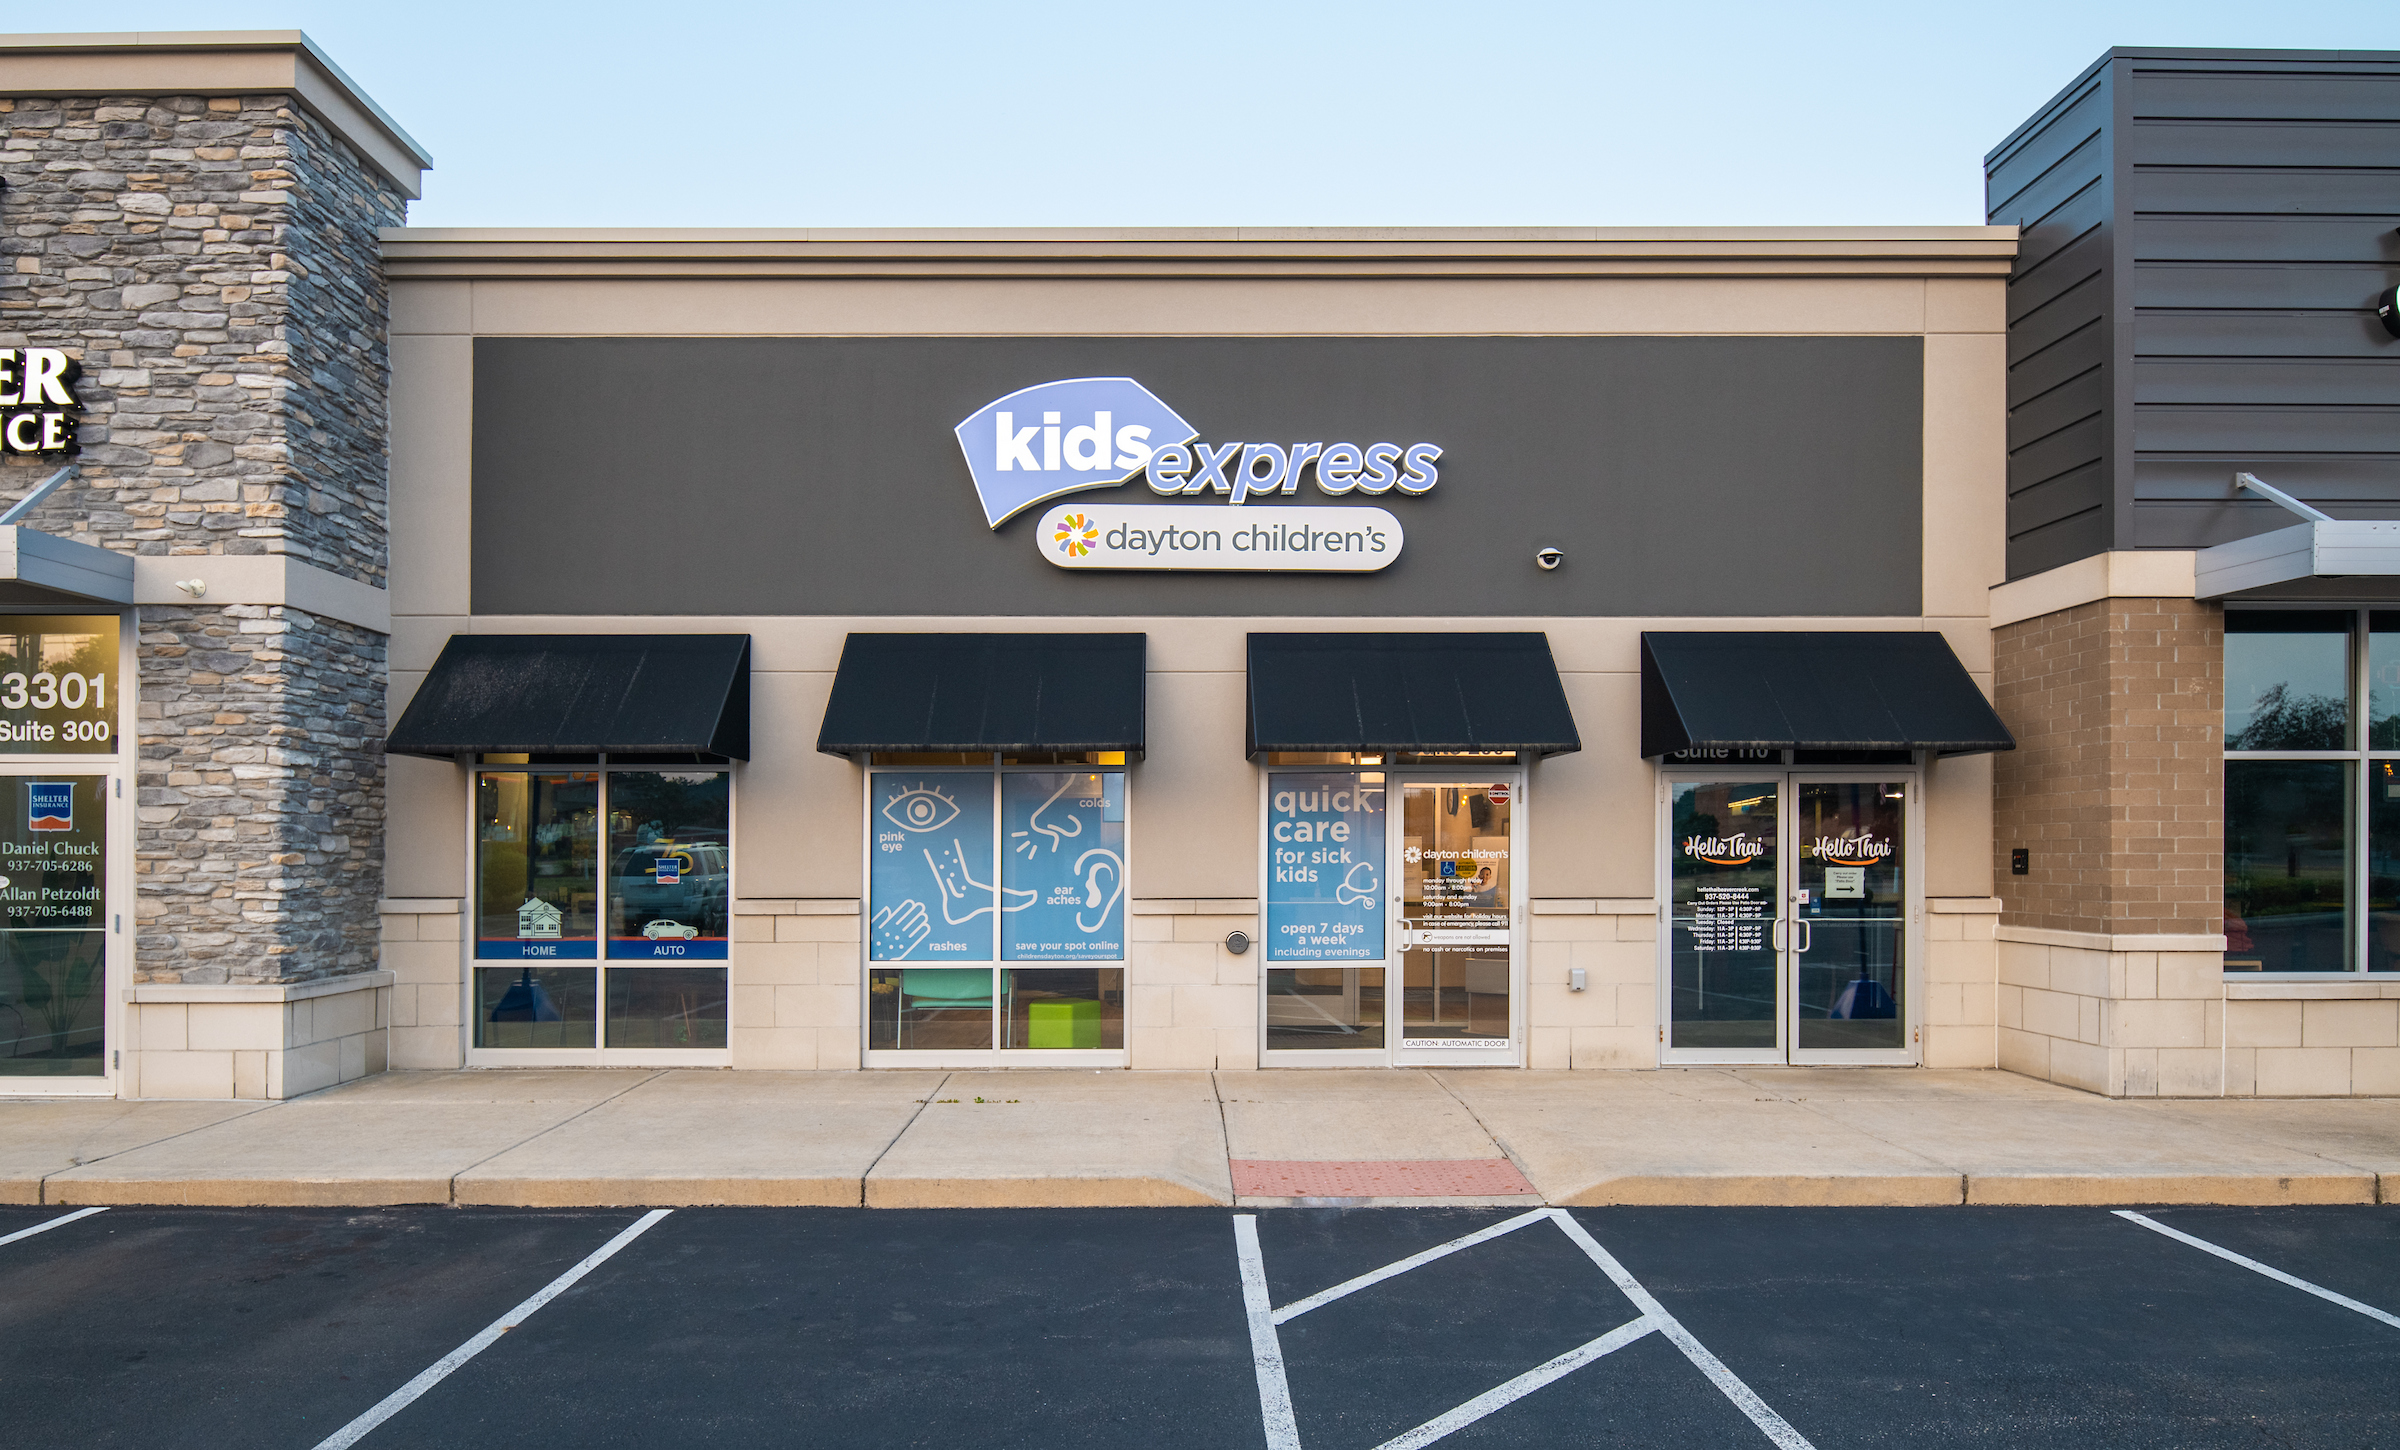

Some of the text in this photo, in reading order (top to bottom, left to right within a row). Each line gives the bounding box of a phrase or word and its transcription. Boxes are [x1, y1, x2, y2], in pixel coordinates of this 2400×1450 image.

[0, 348, 74, 405] ER
[0, 413, 66, 451] CE
[995, 411, 1152, 472] kids
[1146, 442, 1443, 504] express
[1105, 523, 1386, 556] dayton children's
[1, 672, 105, 709] 3301
[0, 720, 109, 741] Suite 300
[1079, 798, 1111, 808] colds
[1274, 785, 1373, 817] quick
[880, 831, 905, 843] pink
[1274, 821, 1350, 842] care
[2, 841, 99, 855] Daniel Chuck
[881, 843, 903, 853] eye
[1685, 832, 1763, 860] Hello Thai
[1812, 833, 1891, 861] Hello Thai
[1275, 848, 1352, 864] for sick
[1423, 849, 1509, 860] dayton children's
[8, 860, 93, 872] 937-705-6286
[1276, 866, 1318, 883] kids
[0, 887, 100, 900] Allan Petzoldt
[1054, 886, 1073, 895] ear
[1047, 895, 1081, 905] aches
[7, 906, 93, 917] 937-705-6488
[1281, 923, 1364, 935] open 7 days
[1298, 934, 1347, 945] a week
[522, 946, 557, 956] HOME
[654, 946, 685, 955] AUTO
[929, 941, 967, 951] rashes
[1040, 943, 1062, 951] your
[1064, 942, 1086, 951] spot
[1089, 941, 1119, 950] online
[1274, 948, 1370, 958] including evenings
